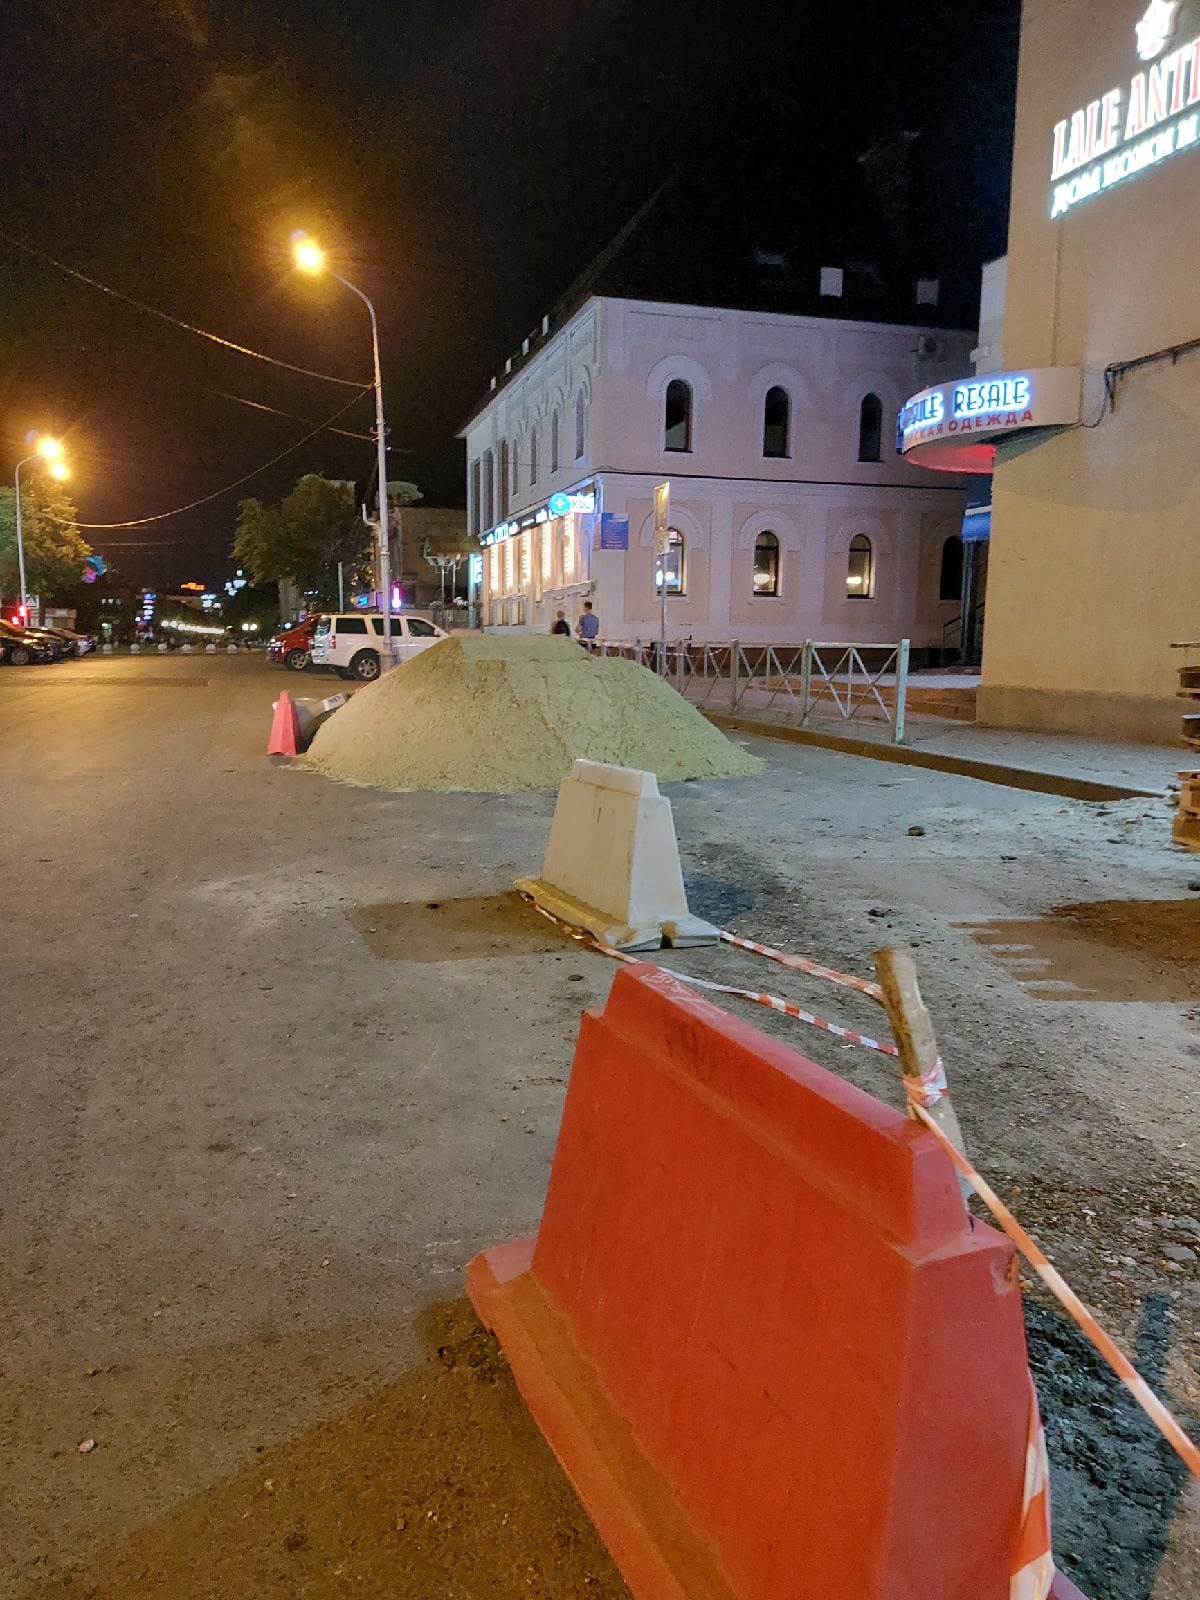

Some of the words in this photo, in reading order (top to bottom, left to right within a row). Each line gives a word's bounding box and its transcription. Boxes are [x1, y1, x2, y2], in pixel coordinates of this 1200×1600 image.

[1051, 87, 1121, 182] LALE
[1050, 165, 1101, 220] ДОМ
[1101, 126, 1175, 188] КОЖИ
[948, 409, 1033, 432] ОДЕЖДА
[954, 380, 1025, 413] RESALE
